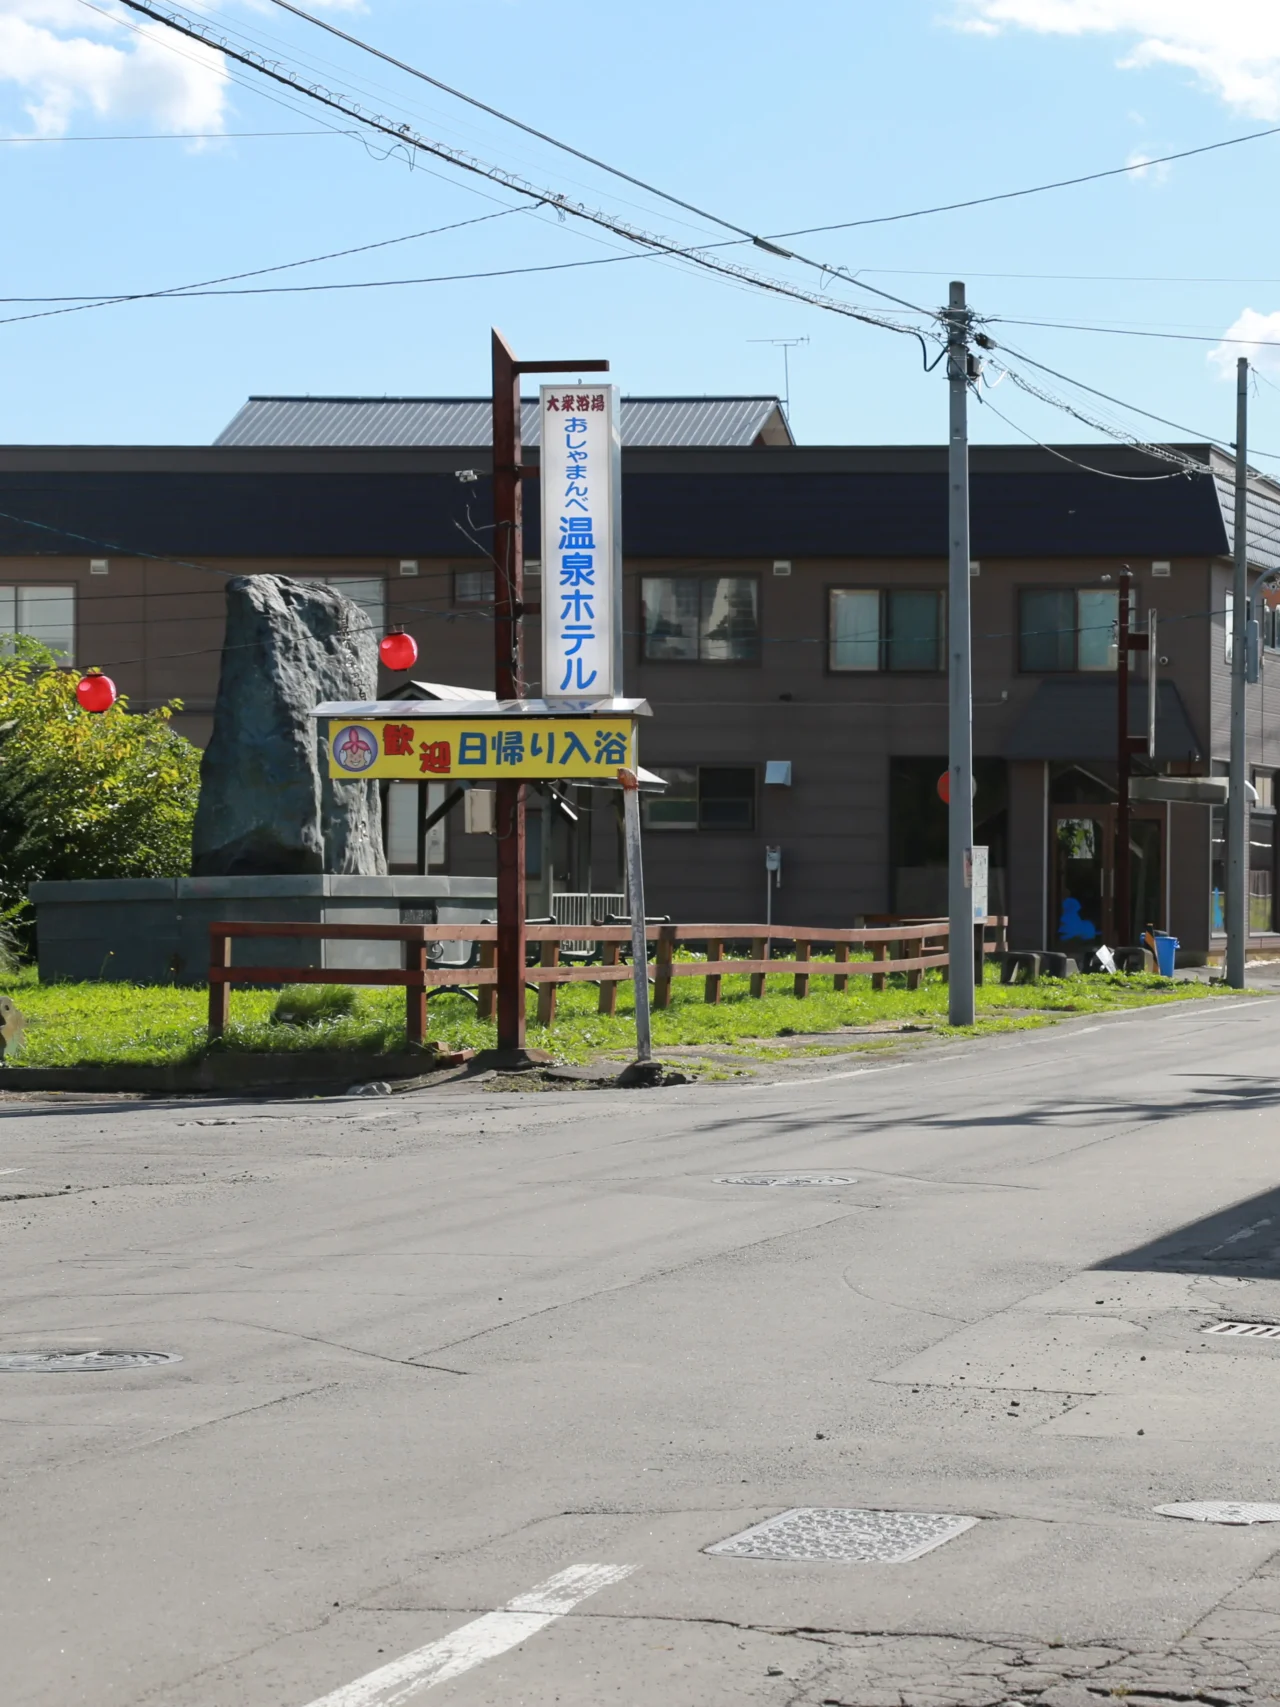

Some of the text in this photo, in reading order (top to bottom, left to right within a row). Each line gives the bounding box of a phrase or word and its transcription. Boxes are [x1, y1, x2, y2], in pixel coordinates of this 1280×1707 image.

[546, 394, 605, 412] 大衆浴場
[382, 724, 628, 774] 歓迎 日帰り入浴
